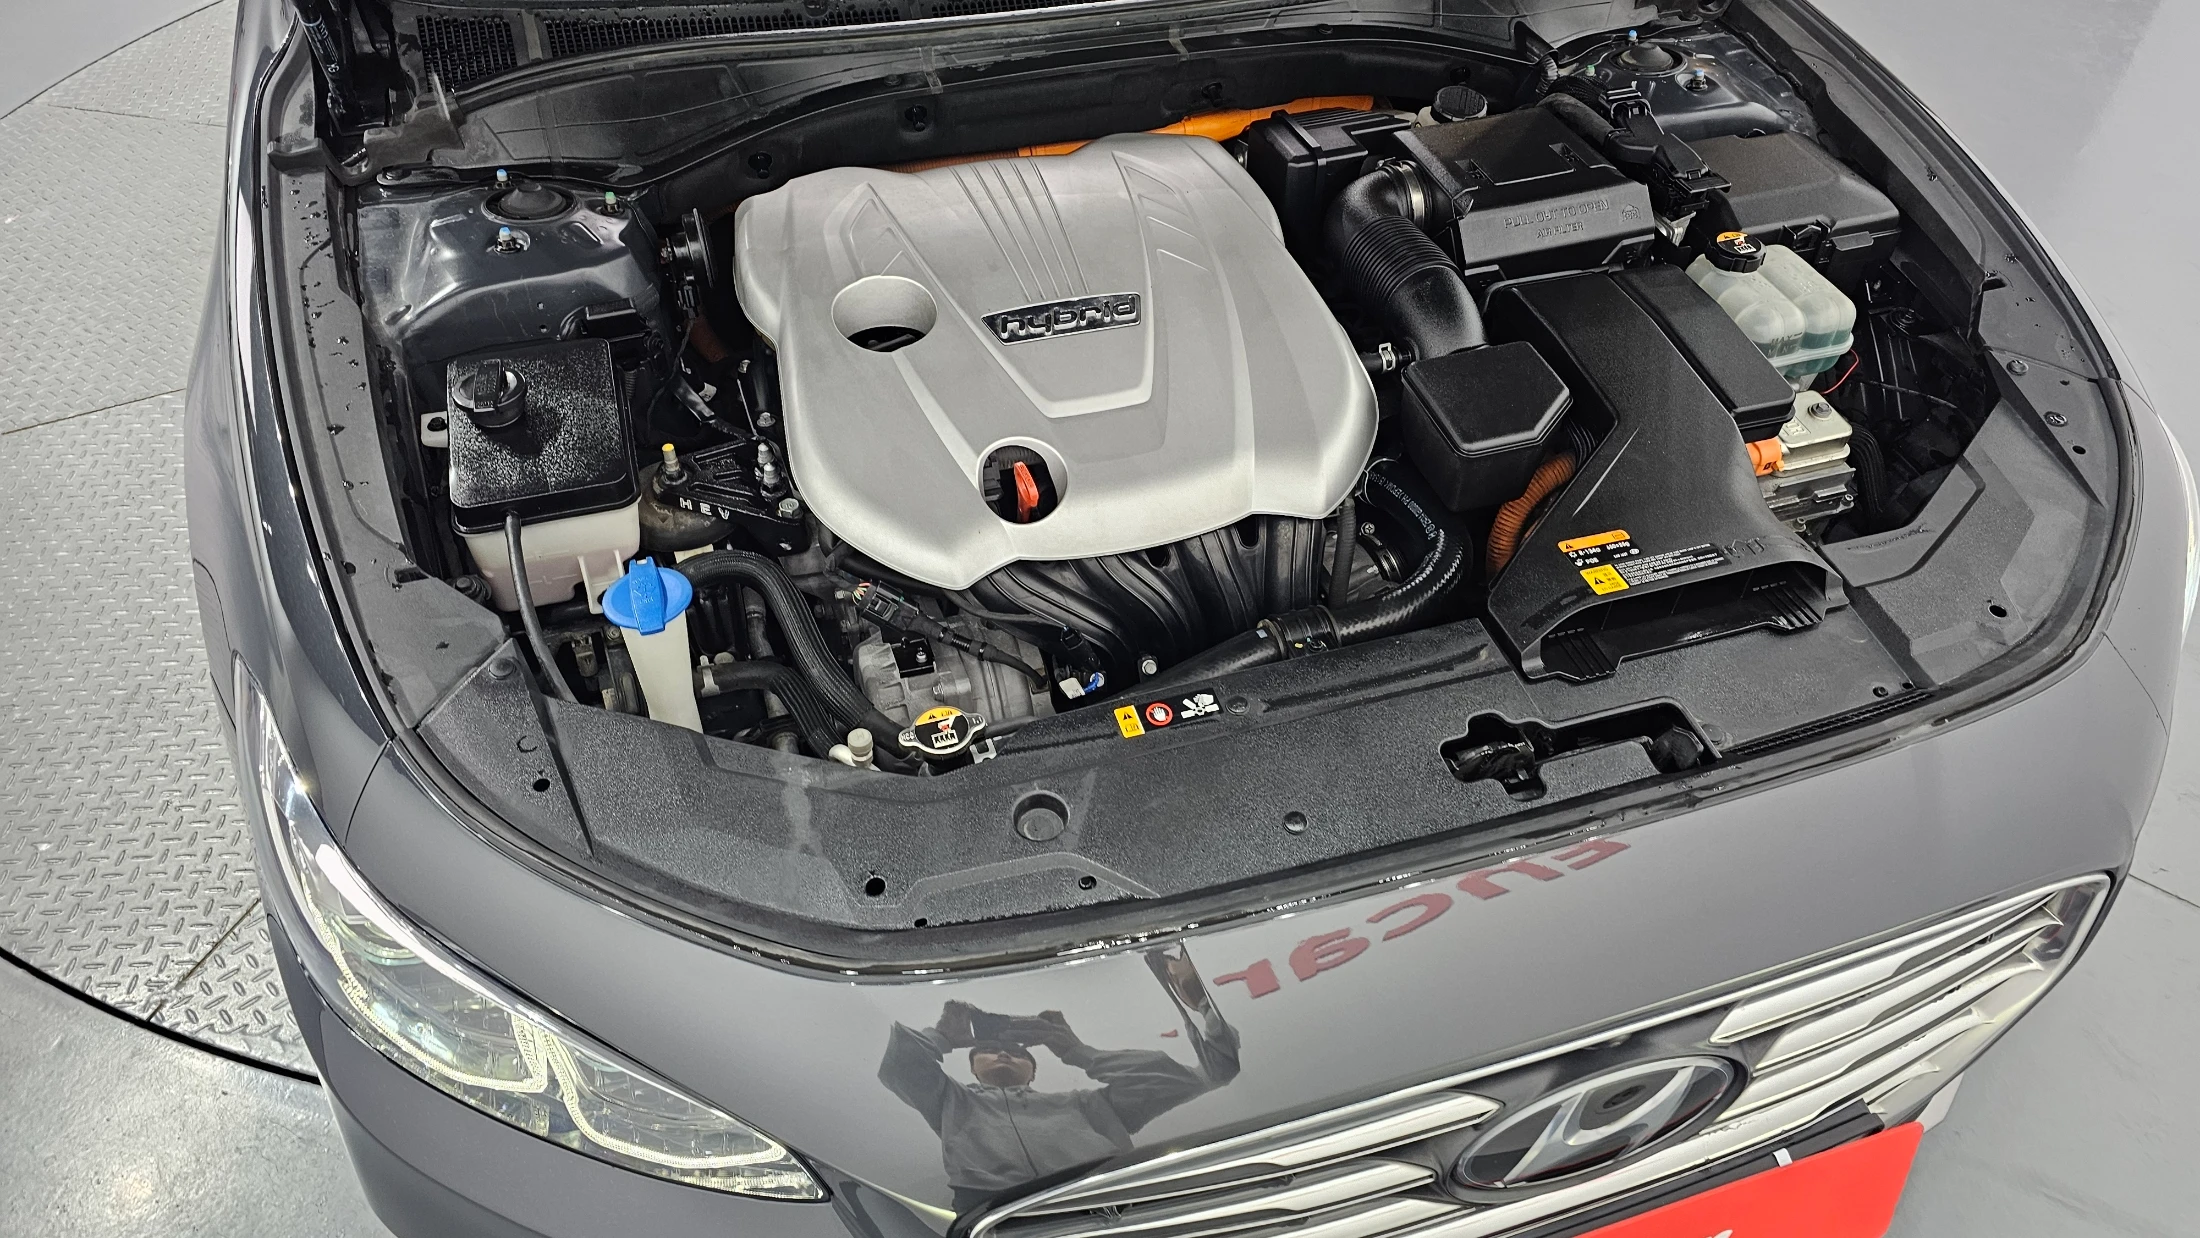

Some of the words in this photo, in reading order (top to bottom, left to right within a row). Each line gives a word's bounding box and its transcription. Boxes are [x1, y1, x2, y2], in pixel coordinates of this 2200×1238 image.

[1503, 214, 1534, 229] PULL
[1535, 209, 1559, 224] OUT
[1561, 205, 1578, 219] TO
[1578, 199, 1610, 214] OPEN
[1536, 227, 1553, 239] AIR
[1554, 221, 1585, 236] FILTER
[1001, 295, 1136, 340] hybrid
[679, 497, 730, 520] HEV
